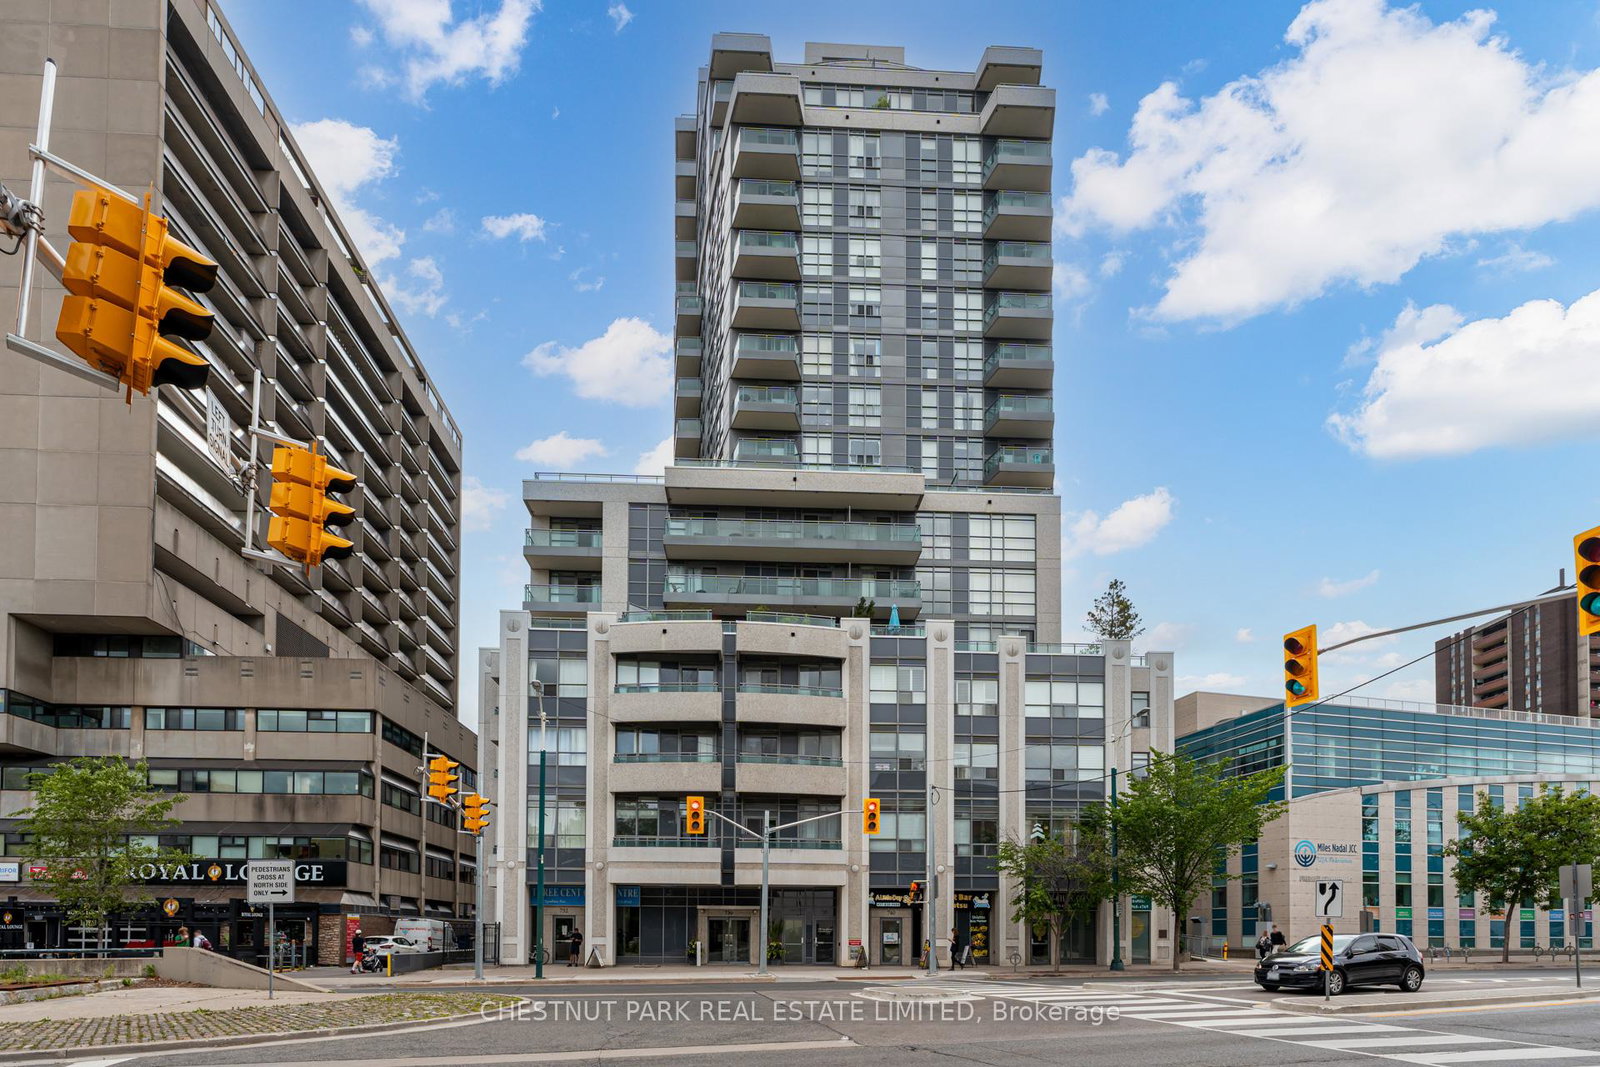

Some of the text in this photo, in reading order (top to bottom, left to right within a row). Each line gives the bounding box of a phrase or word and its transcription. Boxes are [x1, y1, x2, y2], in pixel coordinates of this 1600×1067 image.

[211, 401, 225, 428] LEFT
[211, 417, 227, 447] TURN
[209, 433, 229, 467] SIGNAL
[1317, 843, 1357, 853] Miles Nadal JCC
